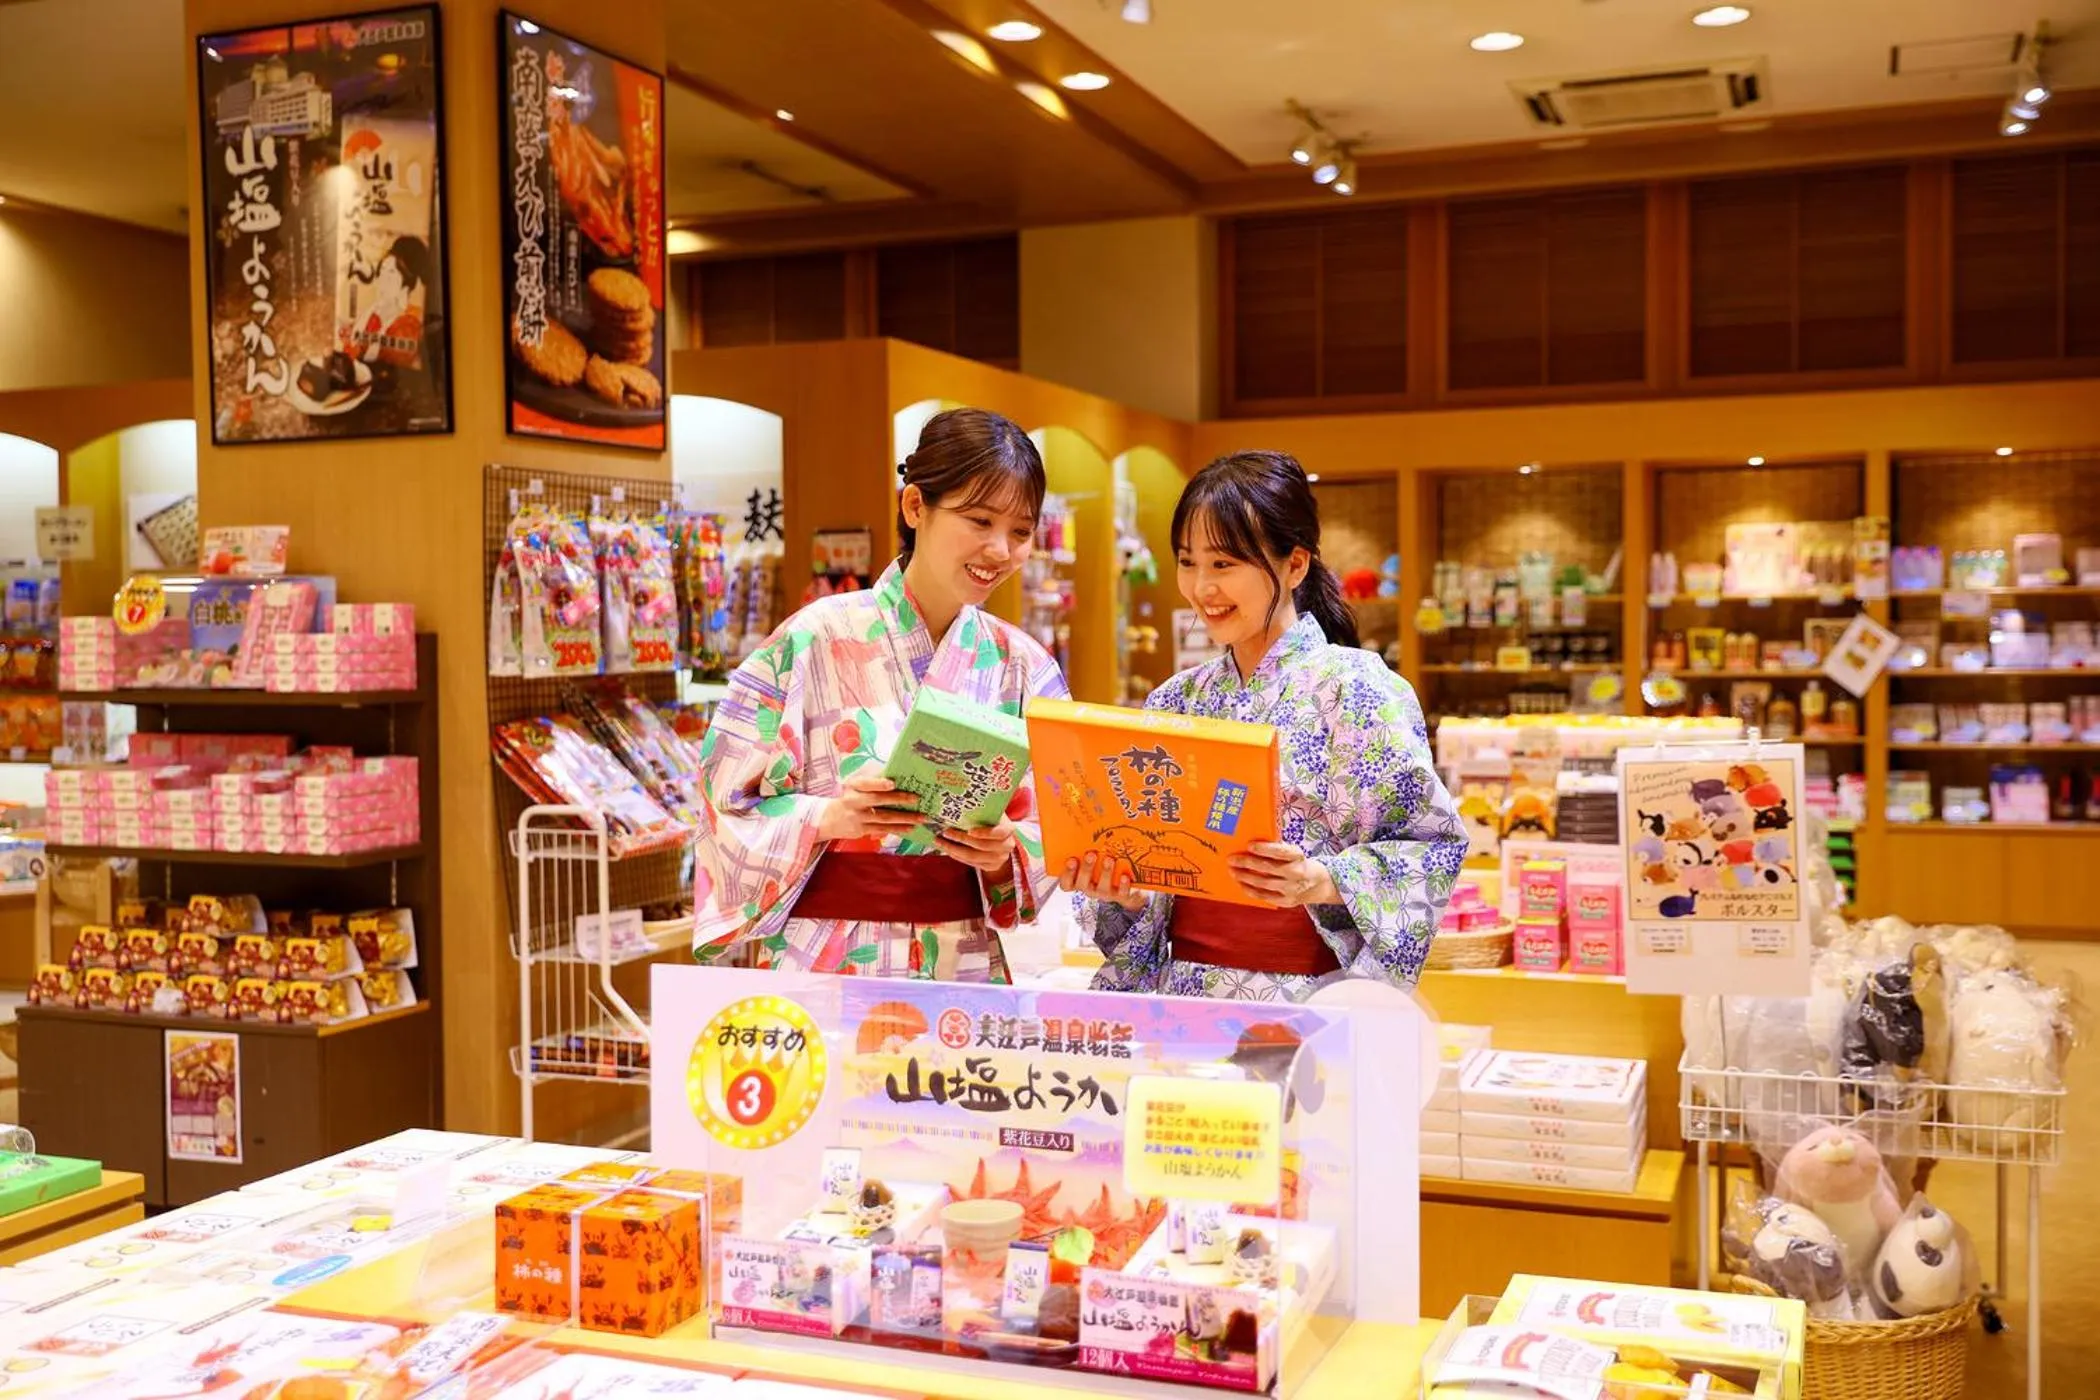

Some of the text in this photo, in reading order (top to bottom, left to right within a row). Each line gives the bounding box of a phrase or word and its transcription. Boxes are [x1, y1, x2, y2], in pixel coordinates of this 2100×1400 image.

[225, 124, 290, 394] 山塩ようかん
[991, 755, 1016, 790] 新潟
[1121, 746, 1182, 823] 柿の種
[718, 1024, 806, 1052] おすすめ
[737, 1076, 762, 1117] 3
[885, 1056, 1118, 1116] 山塩ようか
[1002, 1129, 1072, 1150] 紫花豆入り
[1163, 1160, 1242, 1180] 山塩ようかん
[1081, 1347, 1130, 1371] 12個入
